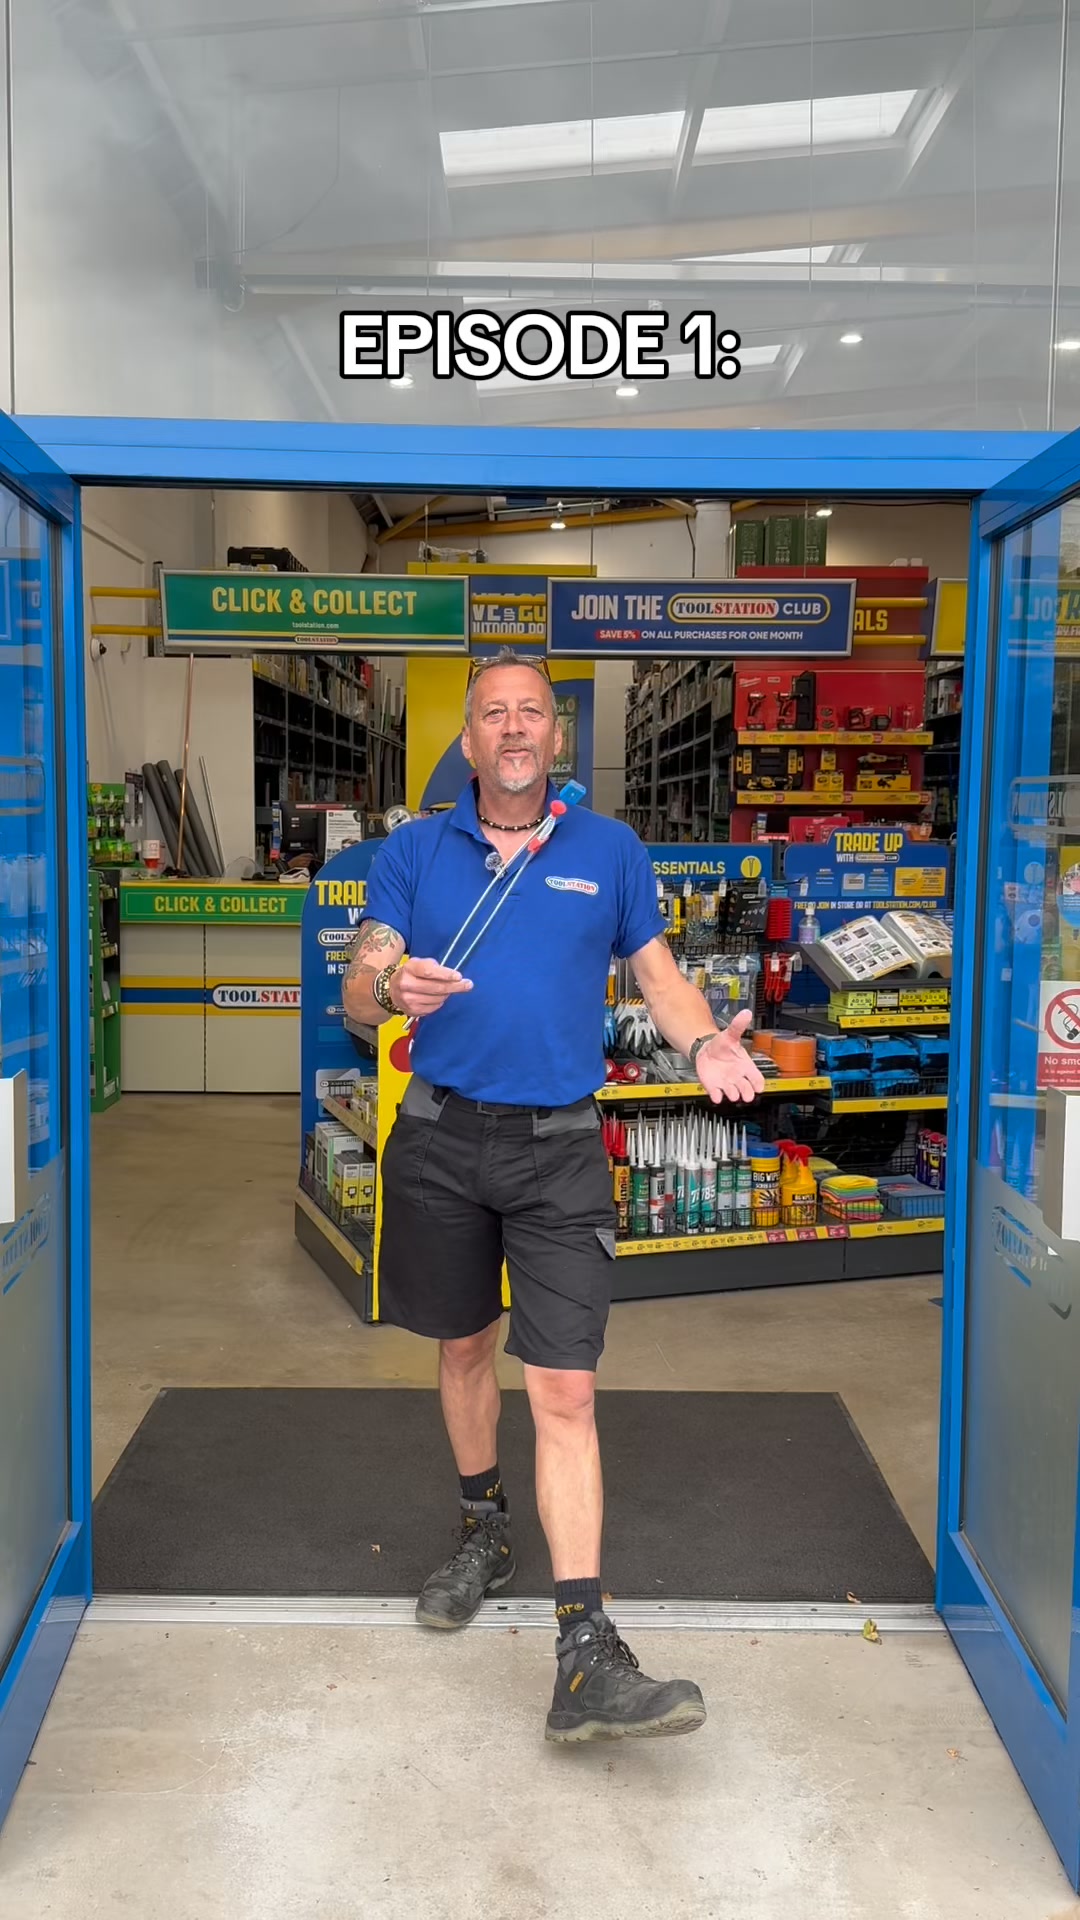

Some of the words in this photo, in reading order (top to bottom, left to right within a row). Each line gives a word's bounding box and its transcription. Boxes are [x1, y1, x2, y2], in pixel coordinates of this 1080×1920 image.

[212, 587, 282, 613] CLICK
[289, 589, 306, 613] &
[313, 590, 417, 615] COLLECT
[571, 595, 618, 620] JOIN
[624, 595, 663, 620] THE
[676, 602, 776, 615] TOOLSTATION
[783, 603, 821, 615] CLUB
[600, 630, 621, 639] SAVE
[623, 630, 636, 639] 5%
[641, 631, 656, 639] ON
[657, 631, 672, 639] ALL
[674, 631, 727, 640] PURCHASES
[729, 631, 747, 640] FOR
[749, 631, 768, 640] ONE
[770, 631, 803, 640] MONTH
[834, 832, 880, 852] TRADE
[883, 832, 904, 852] UP
[836, 853, 854, 863] WITH
[548, 879, 596, 892] TOOLSTATION
[155, 896, 199, 912] CLICK
[205, 896, 215, 912] &
[220, 897, 287, 912] COLLECT
[218, 990, 300, 1003] TOOLSTAT
[1044, 1056, 1058, 1065] No
[753, 1172, 765, 1182] BIG
